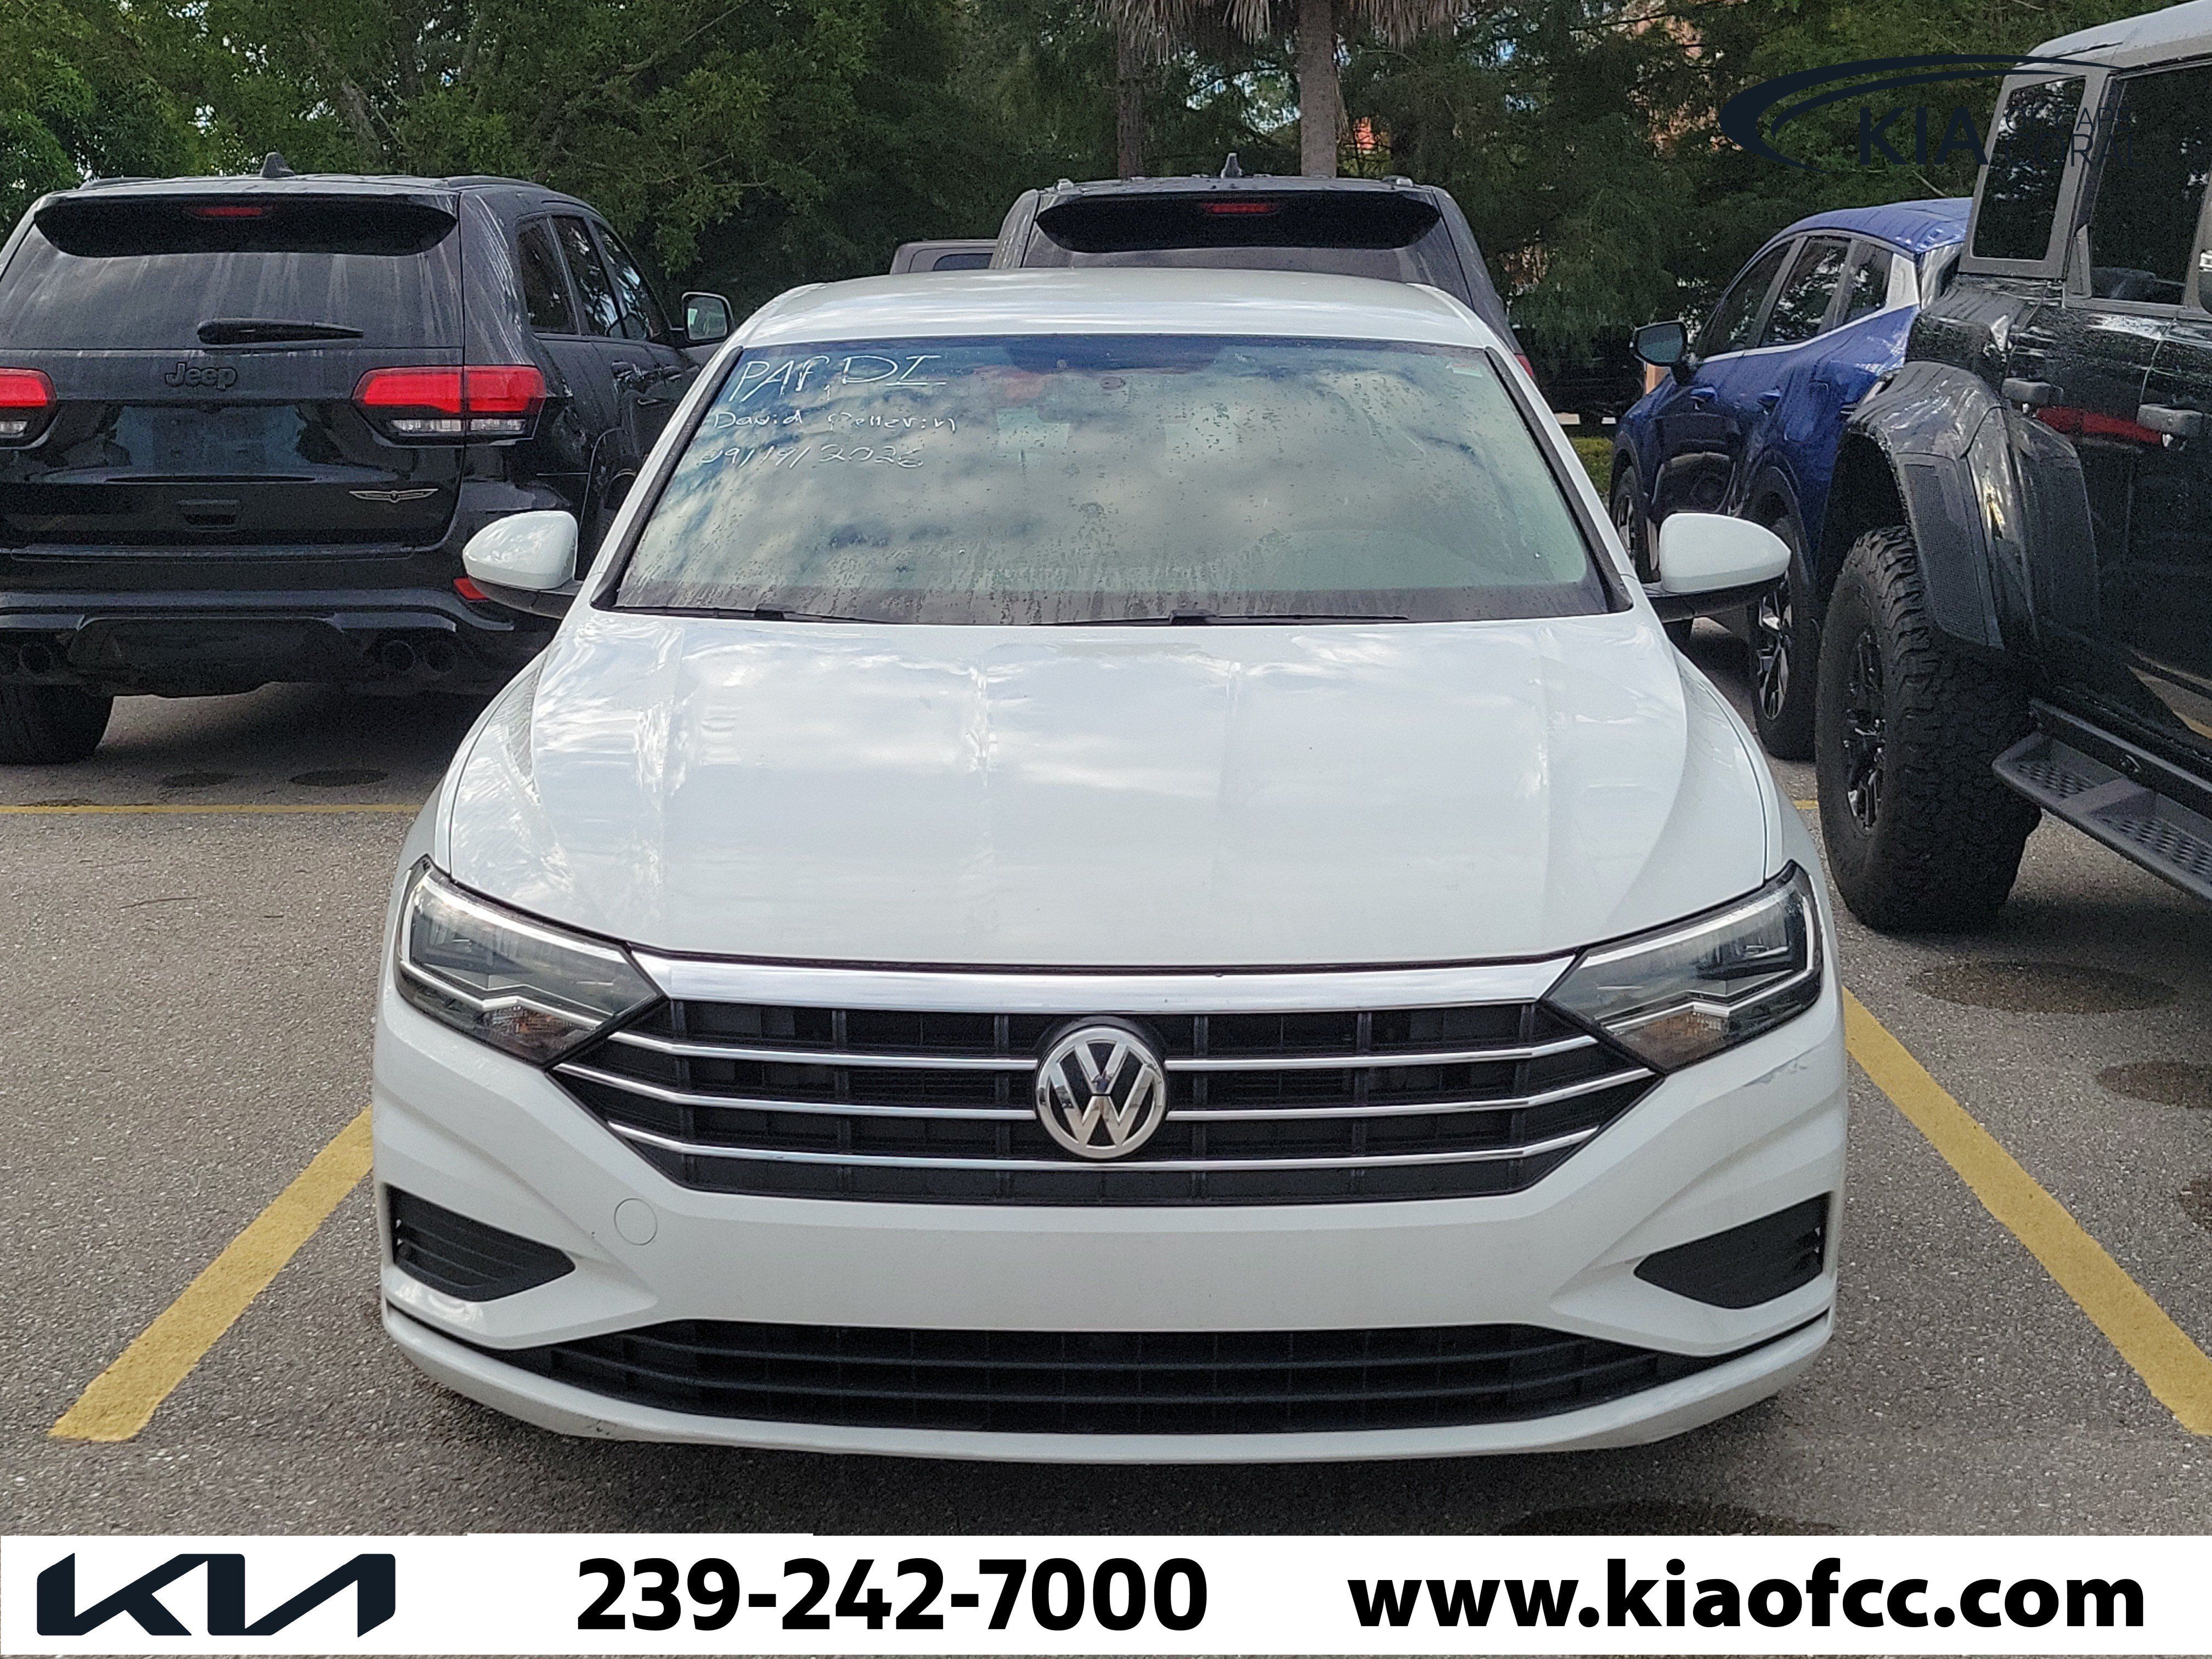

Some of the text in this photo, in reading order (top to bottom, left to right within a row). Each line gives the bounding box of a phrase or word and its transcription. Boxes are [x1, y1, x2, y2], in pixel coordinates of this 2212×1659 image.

[165, 362, 238, 391] Jeep
[714, 410, 803, 429] David
[1037, 1028, 1165, 1159] VW
